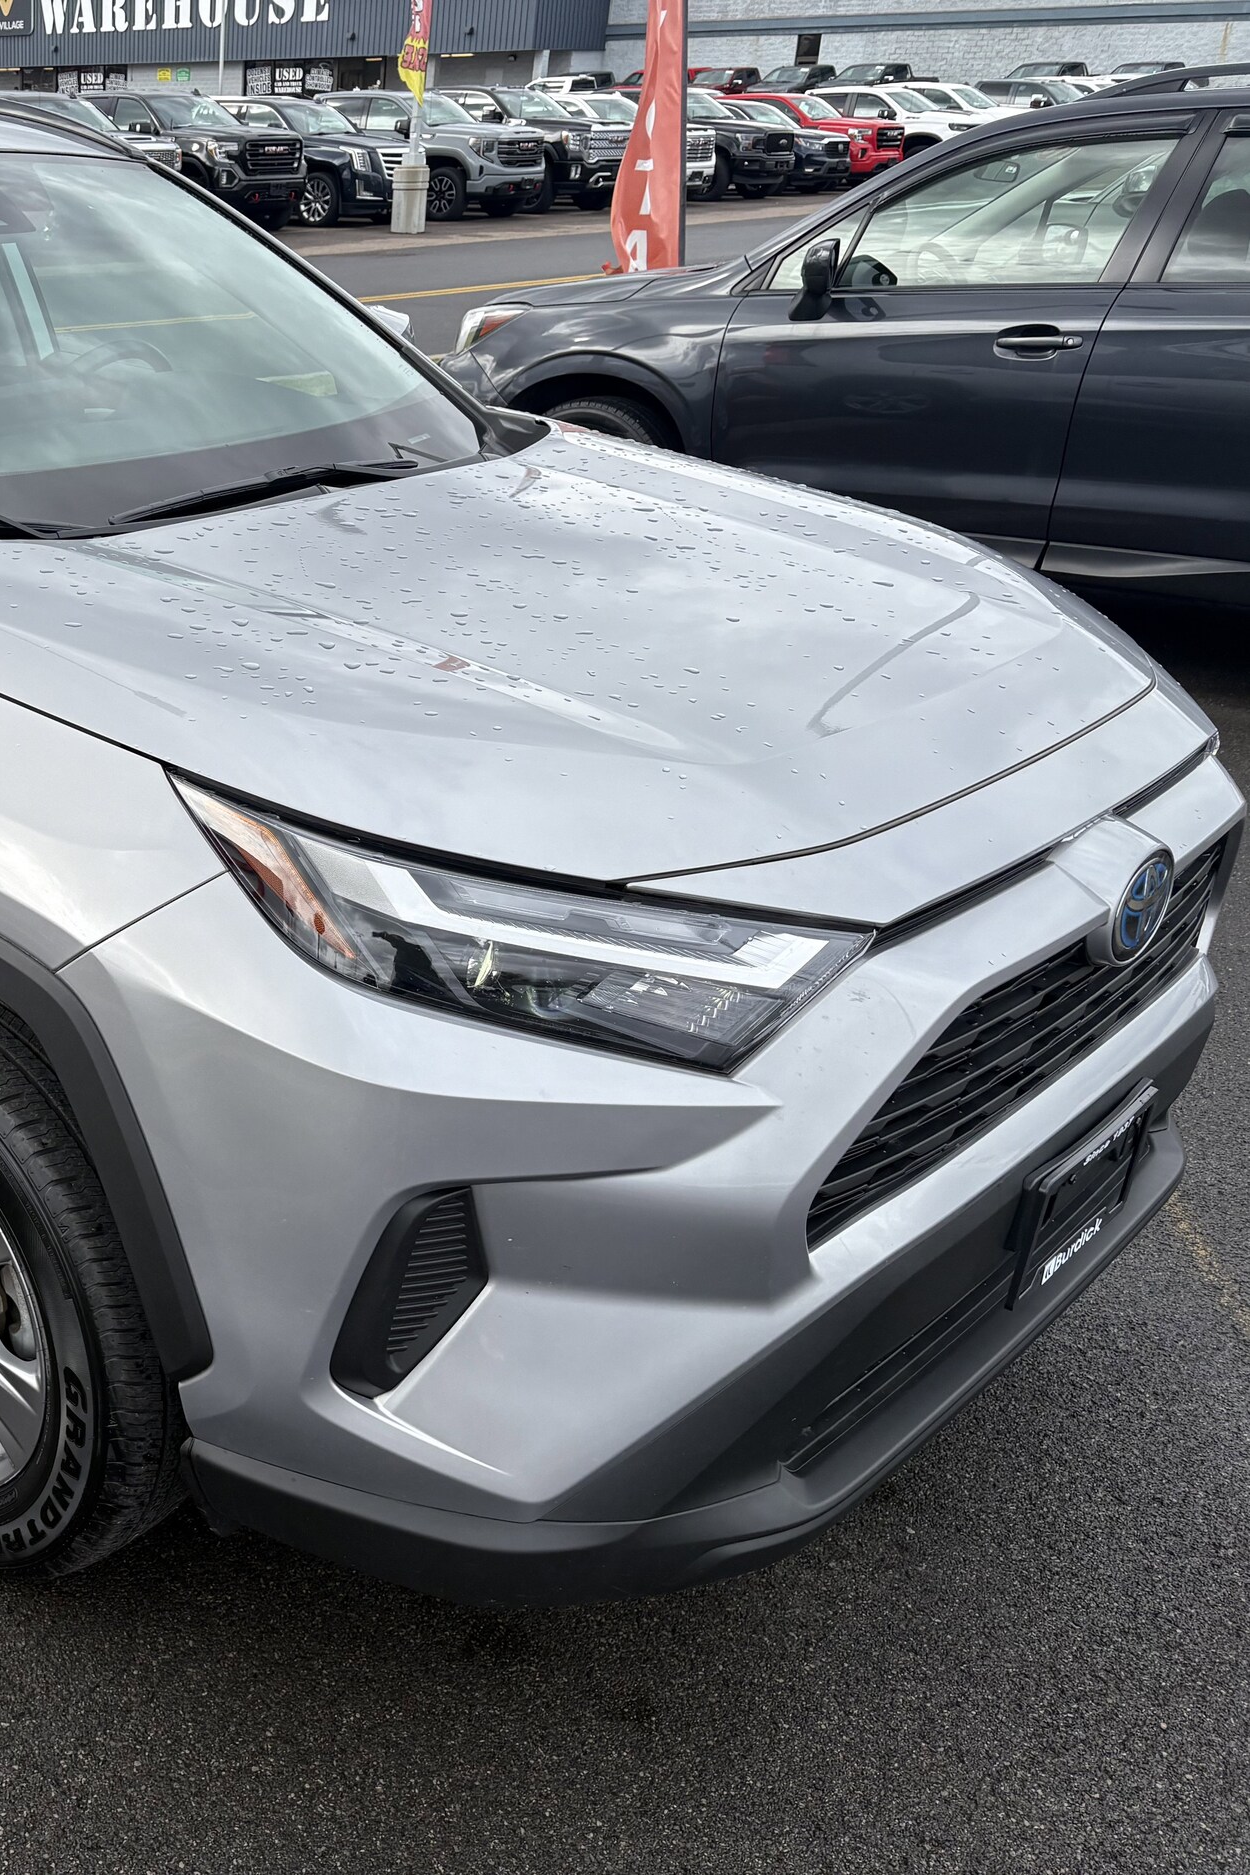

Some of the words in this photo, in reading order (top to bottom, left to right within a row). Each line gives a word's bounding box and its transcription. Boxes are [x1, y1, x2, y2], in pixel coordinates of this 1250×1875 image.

[0, 20, 24, 30] VILLAGE
[80, 73, 104, 84] USED
[275, 67, 303, 80] USED
[247, 82, 271, 95] INSIDE
[1054, 1217, 1103, 1272] Burdick
